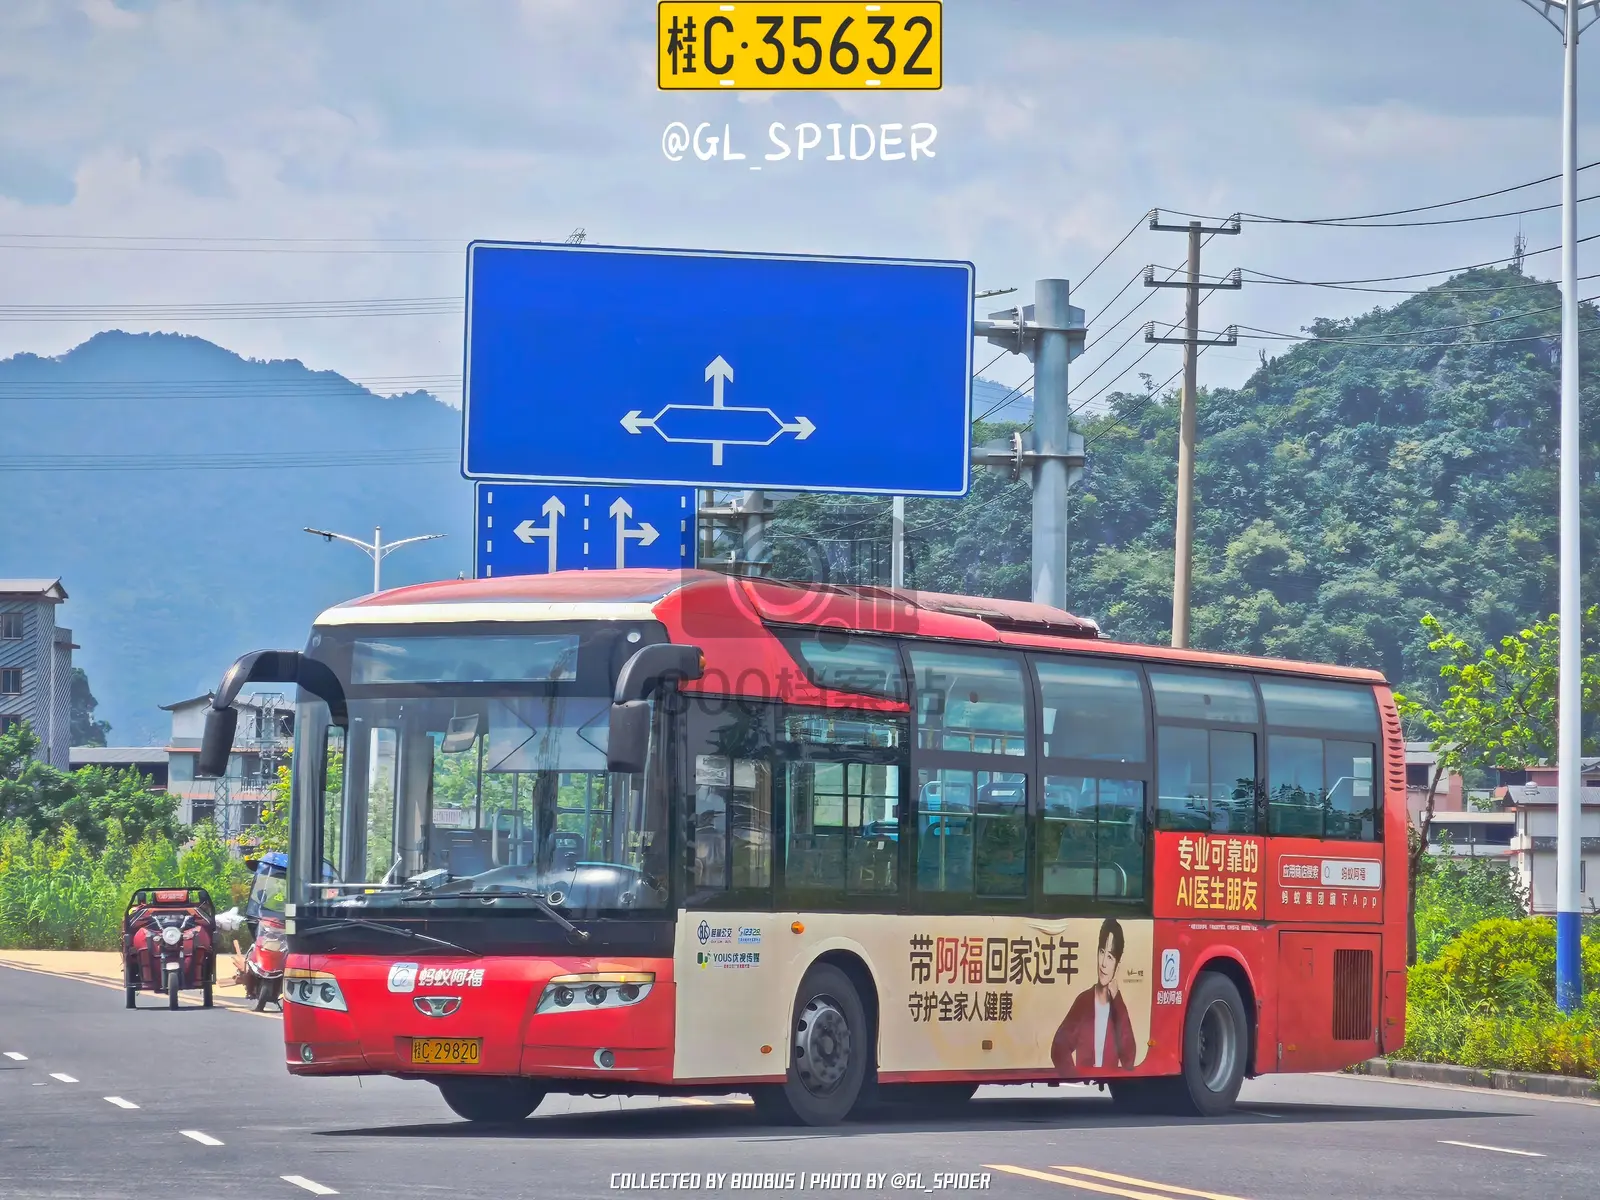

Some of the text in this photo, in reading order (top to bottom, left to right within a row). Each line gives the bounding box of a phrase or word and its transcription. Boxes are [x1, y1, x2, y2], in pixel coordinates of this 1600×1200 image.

[1177, 835, 1258, 873] 专业可靠的
[1176, 875, 1258, 911] AI医生朋友
[418, 967, 486, 987] 蚂蚁阿福
[909, 934, 1080, 985] 带阿福回家过年
[908, 990, 1013, 1022] 守护全家人健康
